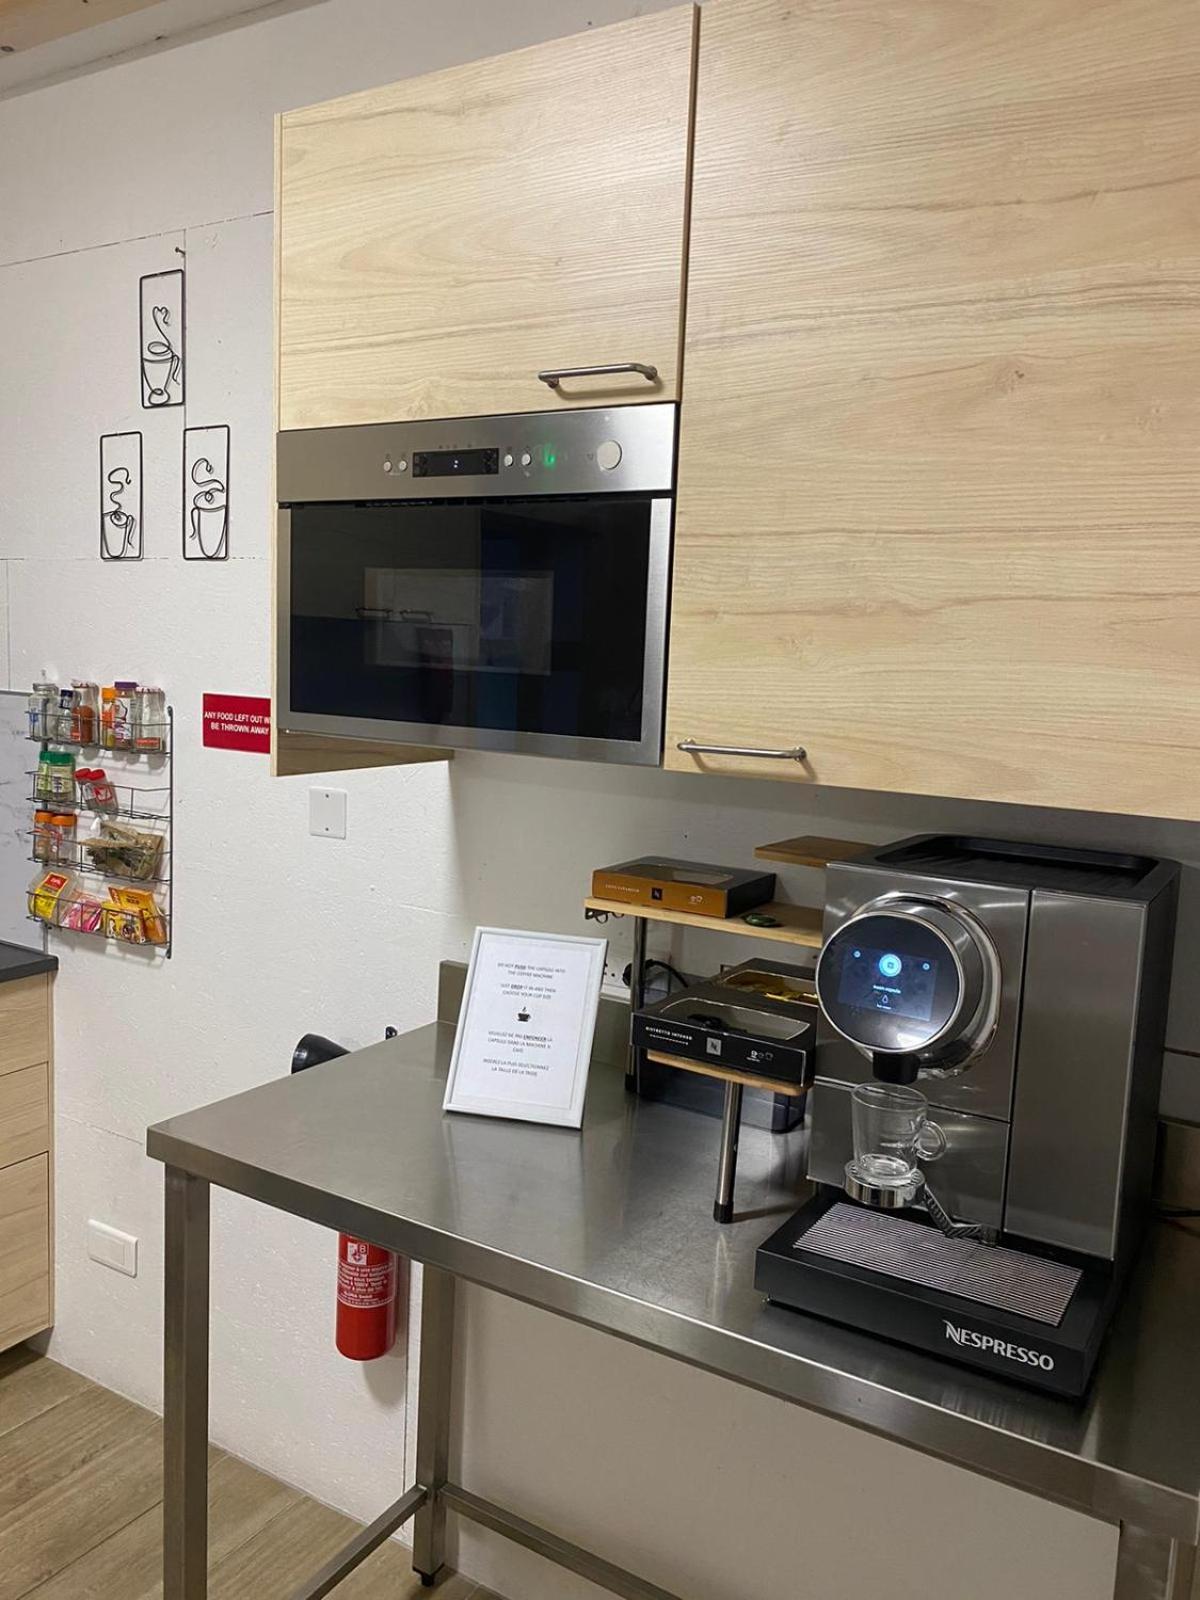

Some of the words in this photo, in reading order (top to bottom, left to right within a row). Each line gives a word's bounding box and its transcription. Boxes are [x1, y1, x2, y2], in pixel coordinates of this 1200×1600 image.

[204, 711, 216, 719] ANY
[217, 712, 233, 720] FOOD
[234, 713, 249, 722] LEFT
[250, 715, 263, 723] OUT
[210, 722, 219, 730] BE
[220, 723, 249, 733] THROWN
[250, 726, 270, 735] AWAY
[942, 1320, 1055, 1372] NESPRESSO
